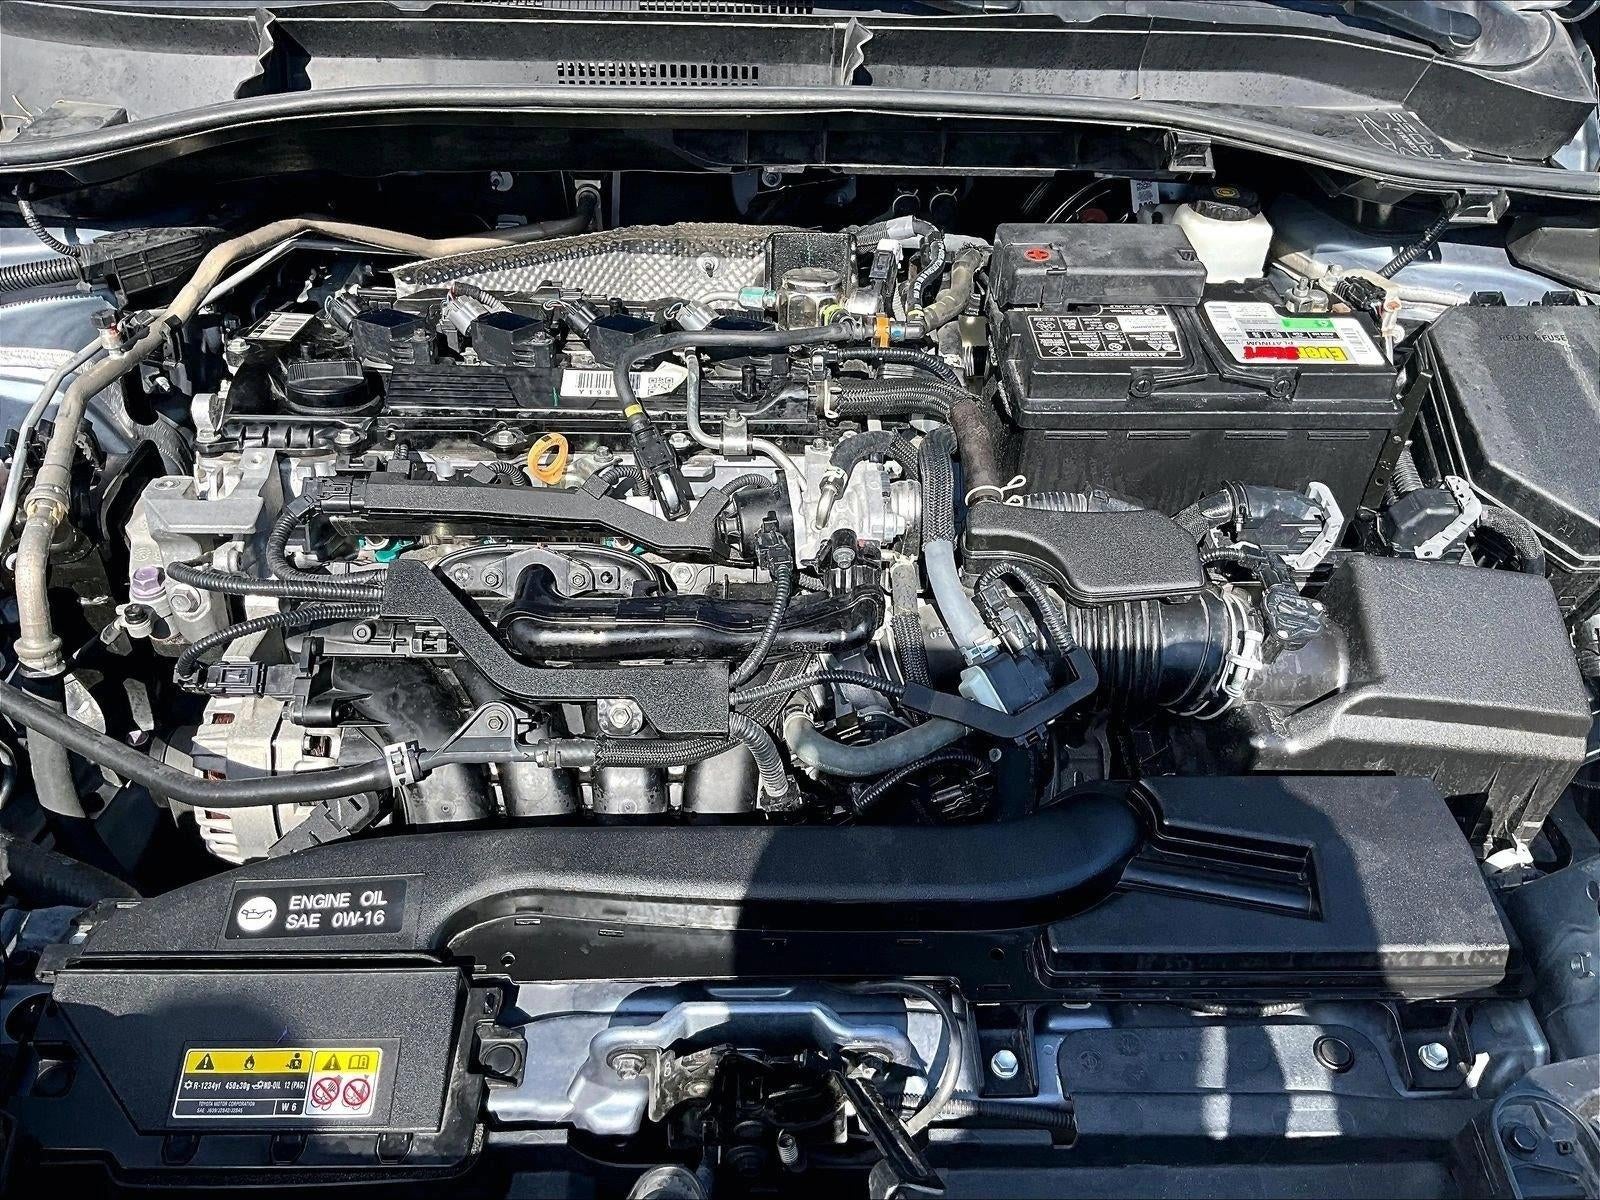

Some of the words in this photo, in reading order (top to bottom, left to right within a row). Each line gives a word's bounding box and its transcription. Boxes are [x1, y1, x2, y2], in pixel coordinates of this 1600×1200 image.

[1499, 334, 1529, 342] RELAY
[1541, 334, 1568, 342] FUSE
[289, 893, 352, 910] ENGINE
[359, 890, 388, 907] OIL
[285, 913, 321, 929] SAE
[331, 909, 386, 927] 0W-16
[193, 1080, 222, 1091] R-1234yf
[281, 1102, 290, 1112] W
[291, 1102, 297, 1111] 6
